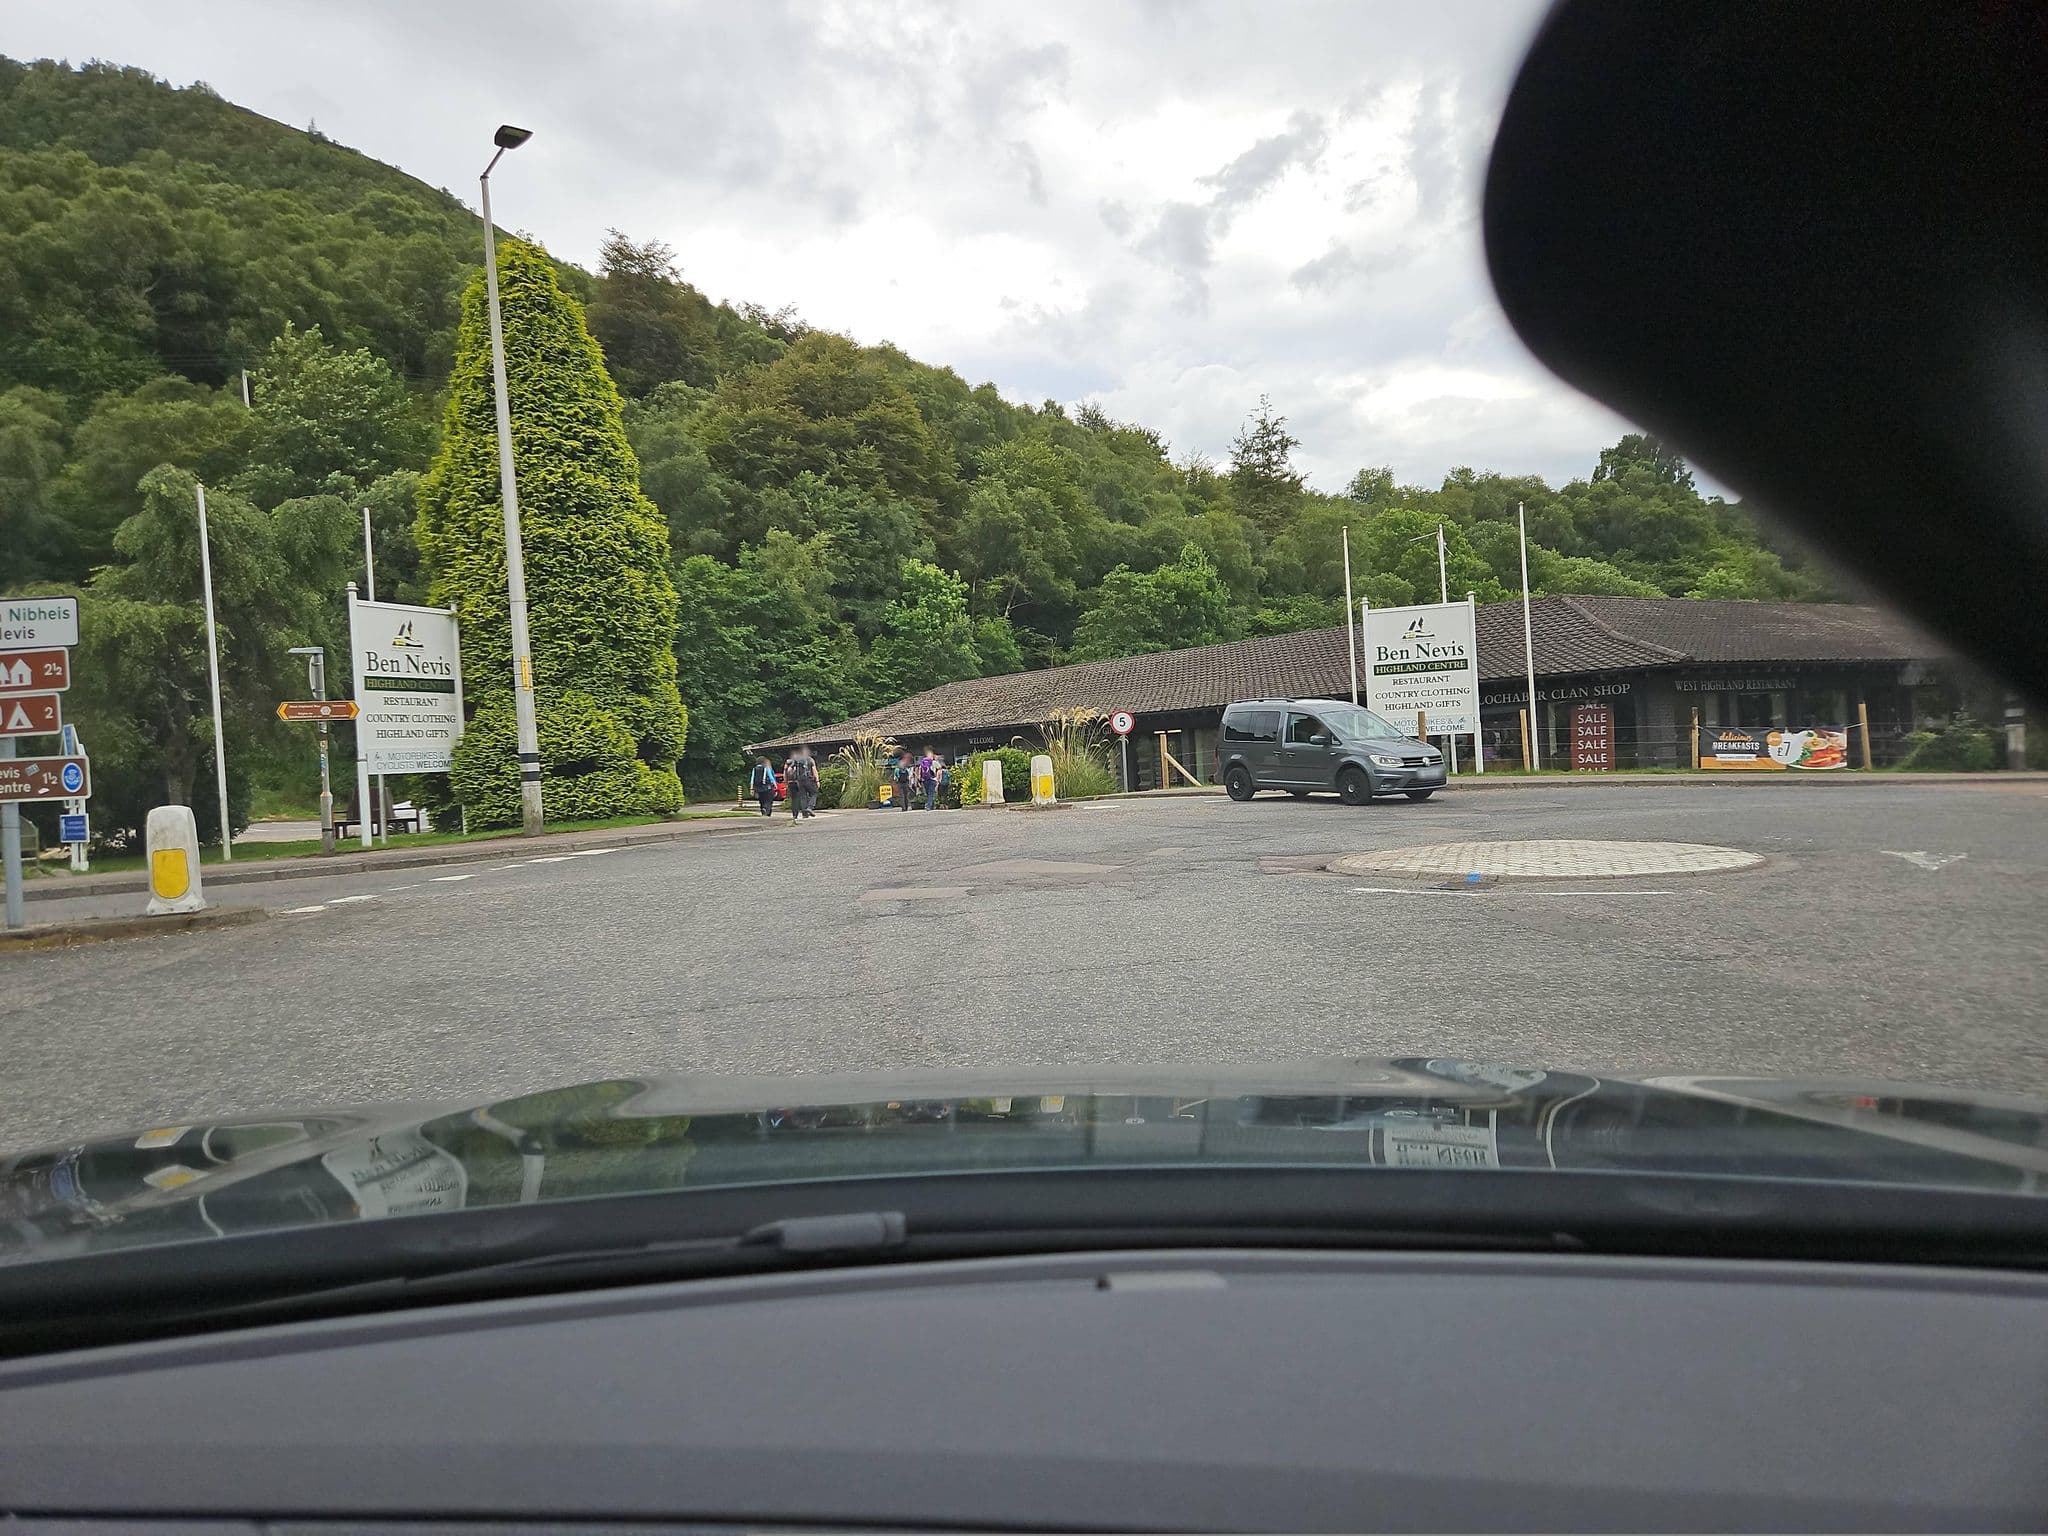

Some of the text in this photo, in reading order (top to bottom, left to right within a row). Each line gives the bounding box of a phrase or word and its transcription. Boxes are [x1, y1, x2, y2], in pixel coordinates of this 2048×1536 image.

[9, 606, 71, 622] Nibheis
[1376, 640, 1465, 662] Ben Nevis
[366, 651, 451, 675] Ben Nevis
[1375, 660, 1467, 674] HIGHLAND CENTRE
[367, 678, 417, 689] HIGHLAND
[1392, 675, 1451, 686] RESTAURANT
[1674, 680, 1699, 692] WEST
[1700, 679, 1744, 691] HIGHLAND
[1374, 686, 1471, 700] COUNTRY CLOTHING
[1479, 683, 1631, 705] OCHABR CLAN SHOP
[383, 696, 439, 707] RESTAURANT
[1384, 699, 1461, 711] HIGHLAND GIFTS
[44, 707, 54, 720] 2
[366, 713, 457, 724] COUNTRY CLOTHING
[1577, 713, 1608, 724] SALE
[1119, 716, 1126, 727] 5
[376, 729, 449, 739] HIGHLAND GIFTS
[1577, 725, 1608, 736] SALE
[968, 736, 995, 745] WELCOME
[1577, 739, 1608, 750] SALE
[1712, 742, 1760, 751] BREAKFASTS
[1777, 741, 1791, 756] £7
[387, 751, 438, 761] MOTORBIKES
[1577, 752, 1608, 764] SALE
[376, 759, 451, 770] CYCLISTS WELCOM
